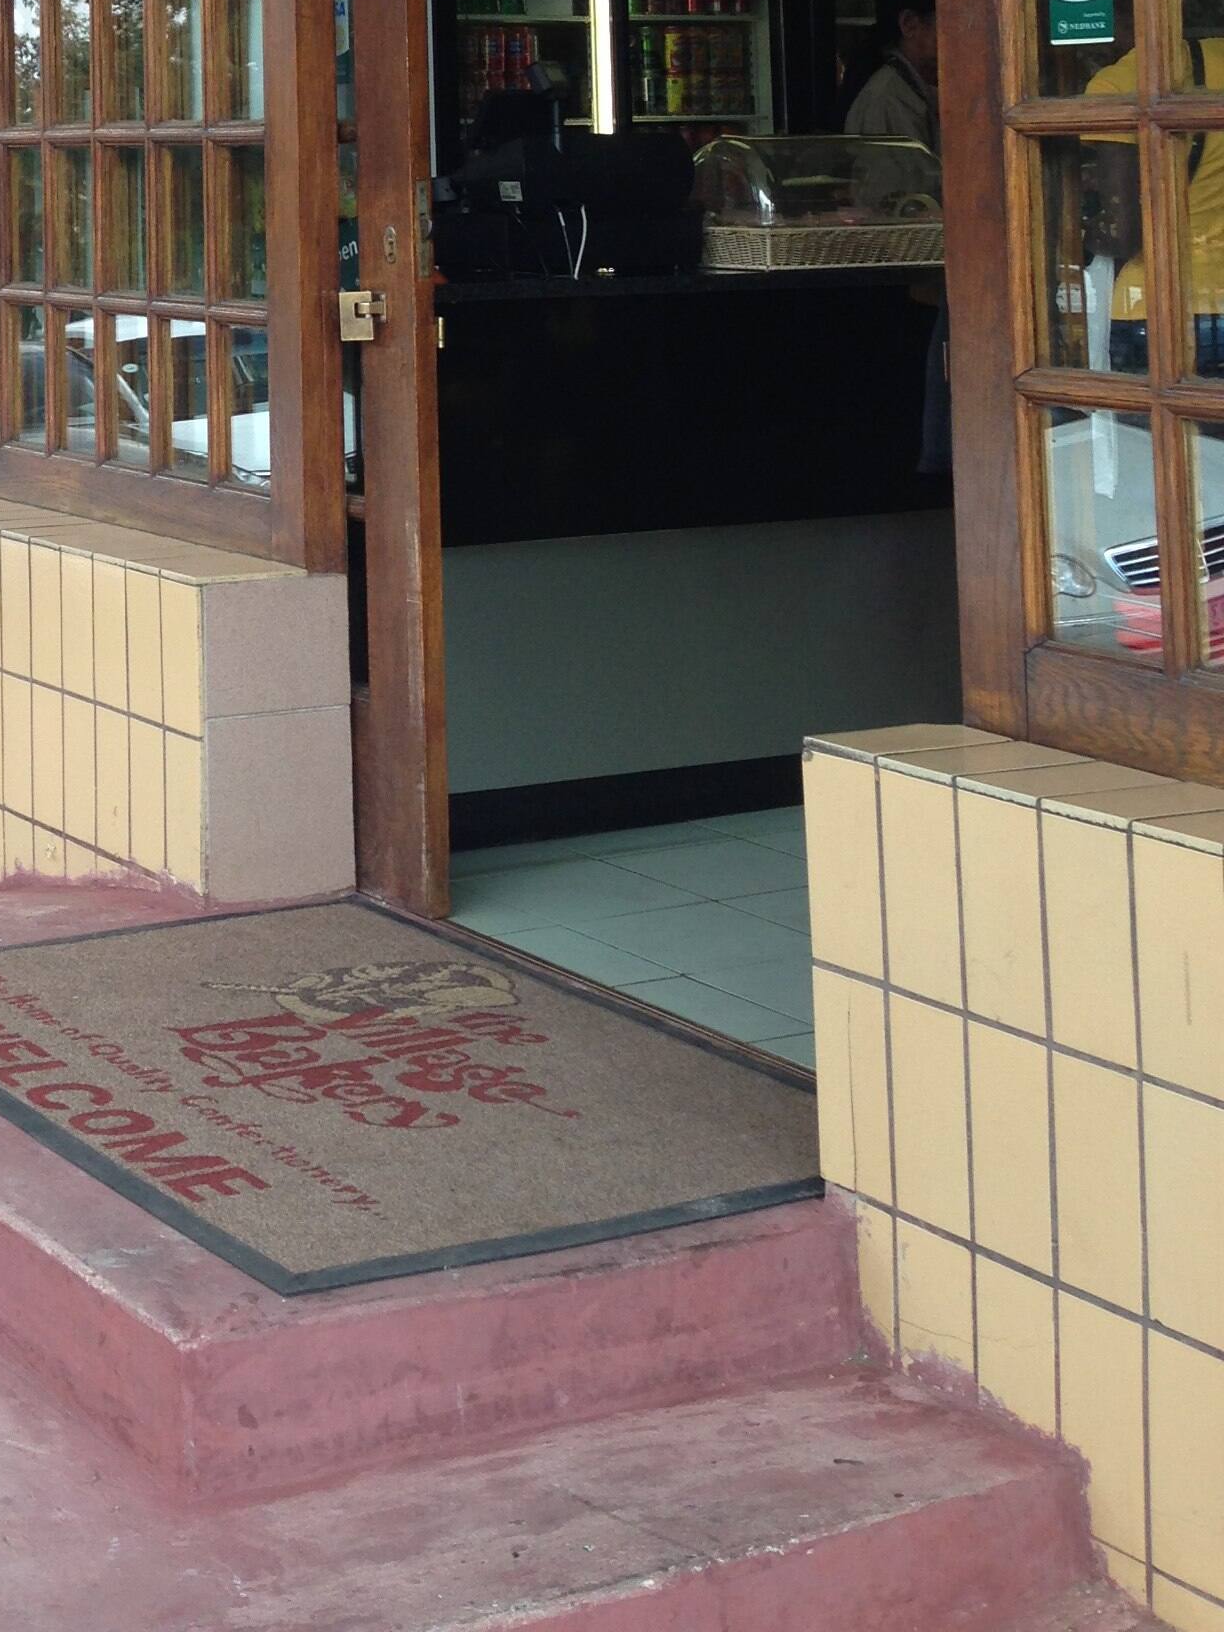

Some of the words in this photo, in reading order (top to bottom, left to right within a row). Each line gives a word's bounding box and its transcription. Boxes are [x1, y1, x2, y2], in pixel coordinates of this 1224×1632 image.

[339, 241, 358, 260] en
[59, 1027, 105, 1041] of
[447, 1011, 550, 1046] the
[163, 1012, 461, 1129] Bakery
